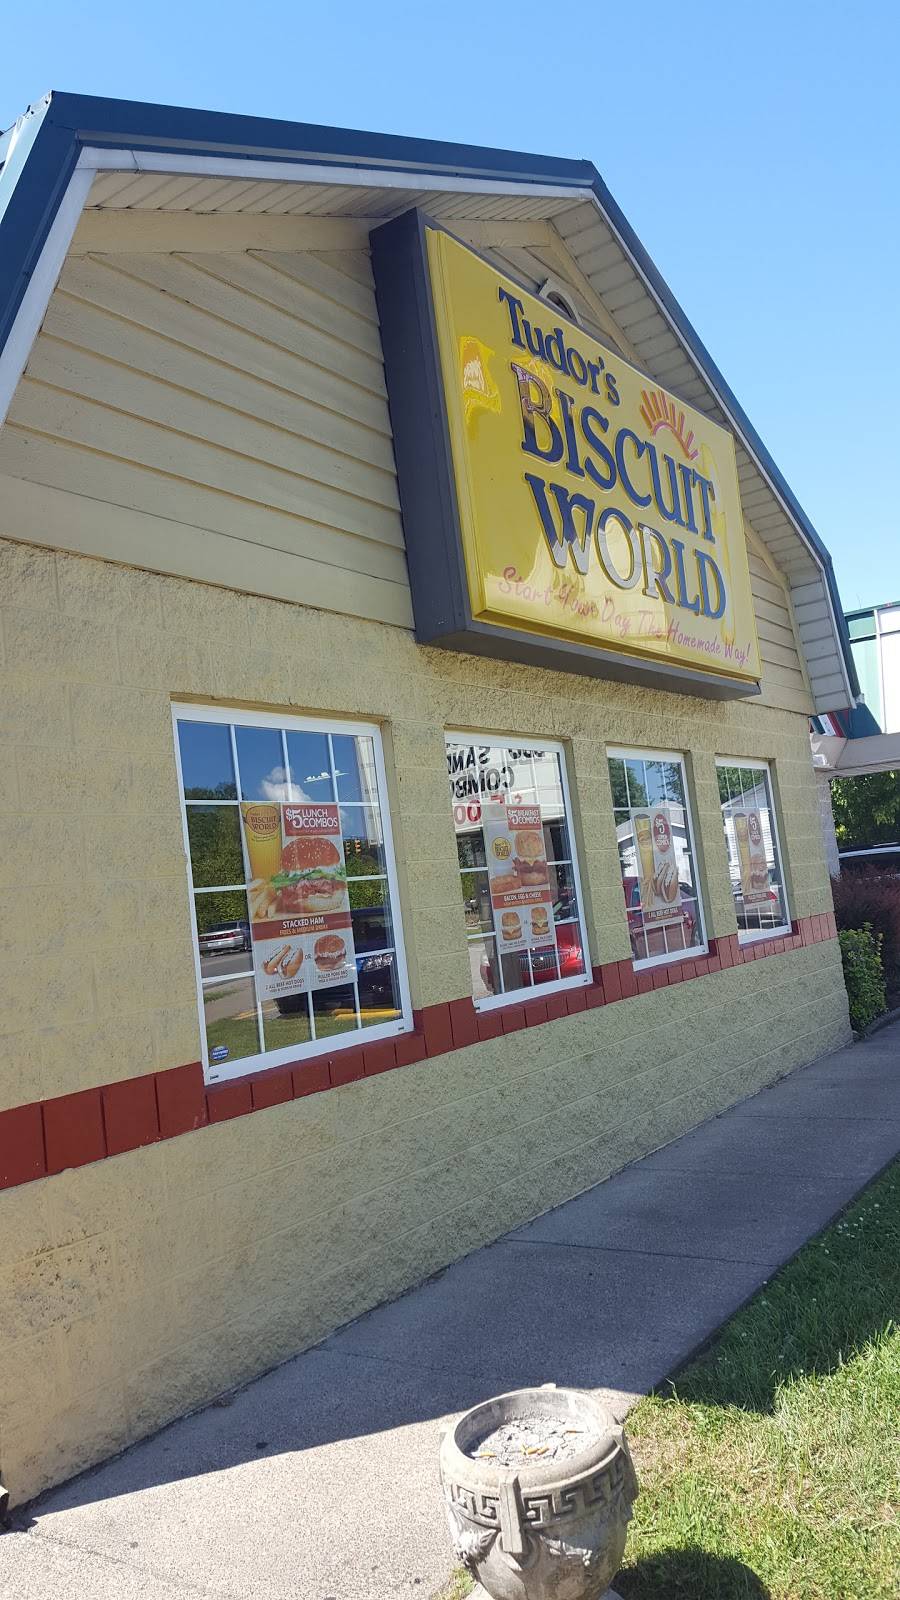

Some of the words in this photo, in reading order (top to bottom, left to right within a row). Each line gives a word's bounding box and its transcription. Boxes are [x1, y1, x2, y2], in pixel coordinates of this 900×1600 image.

[498, 287, 620, 407] Tudor's
[511, 362, 716, 544] BISCUIT
[524, 472, 726, 620] WORLD
[498, 566, 552, 607] Start
[556, 583, 600, 619] Your
[602, 595, 632, 638] Day
[638, 610, 663, 639] The
[667, 619, 721, 655] Homemade
[724, 635, 751, 671] Way!
[285, 807, 302, 829] $5
[301, 808, 329, 818] LUNCH
[302, 817, 338, 828] COMBOS
[518, 816, 540, 824] COMBOS
[282, 918, 310, 929] STACKED
[310, 915, 325, 925] HAM
